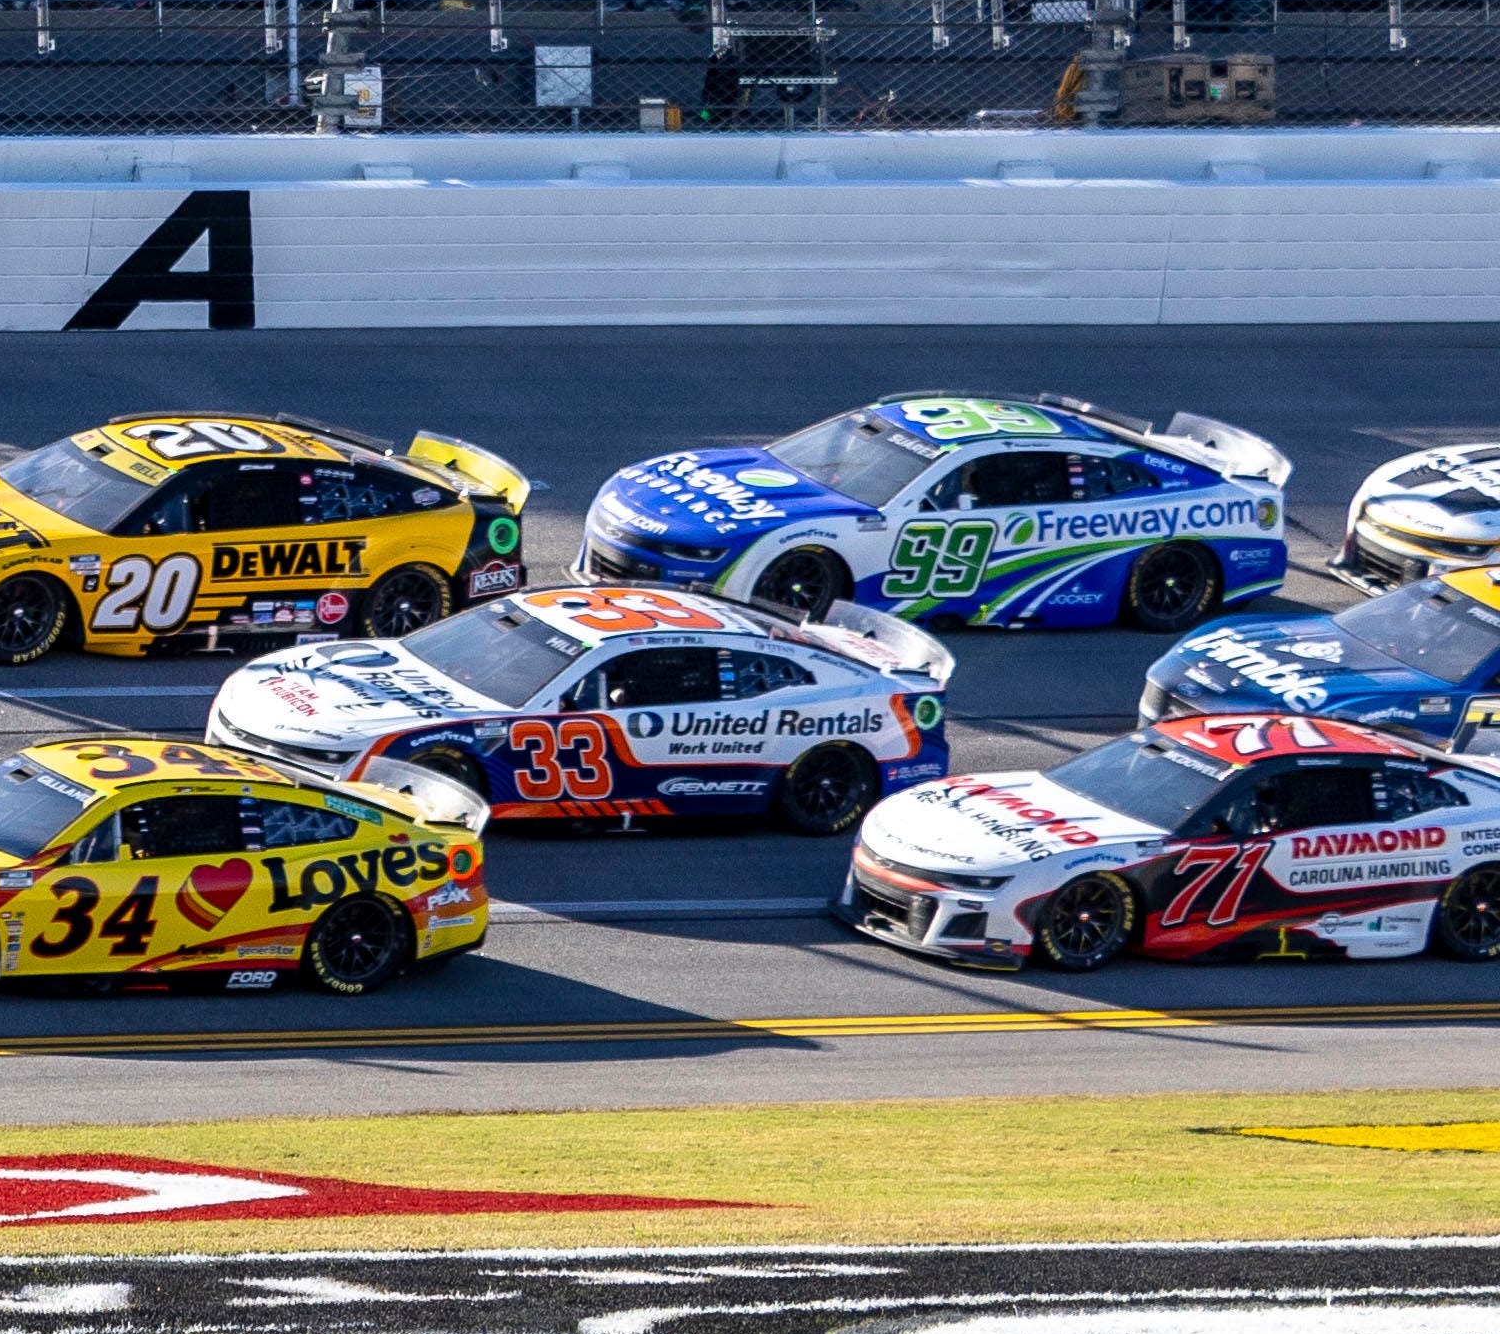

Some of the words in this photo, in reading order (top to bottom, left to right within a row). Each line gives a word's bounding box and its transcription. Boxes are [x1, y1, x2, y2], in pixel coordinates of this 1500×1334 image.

[128, 463, 160, 480] BELL
[1038, 498, 1255, 542] Freeway.com
[882, 520, 996, 598] 99
[88, 553, 201, 632] 20
[523, 587, 725, 631] 33
[1049, 593, 1102, 605] JOCKEY
[545, 636, 579, 656] HILL
[1181, 628, 1329, 713] Trimble
[671, 710, 769, 737] United
[775, 708, 883, 736] Rentals
[509, 719, 613, 800] 33
[668, 742, 707, 755] Work
[711, 741, 764, 754] United
[668, 780, 768, 793] BENNETT
[943, 777, 1100, 847] RAYMOND
[1291, 826, 1448, 861] RAYMOND
[1161, 839, 1275, 929] 71
[1289, 865, 1364, 887] CAROLINA
[1367, 860, 1451, 881] HANDLING
[29, 875, 161, 959] 34
[426, 888, 472, 911] PEAK
[227, 970, 278, 983] FORD
